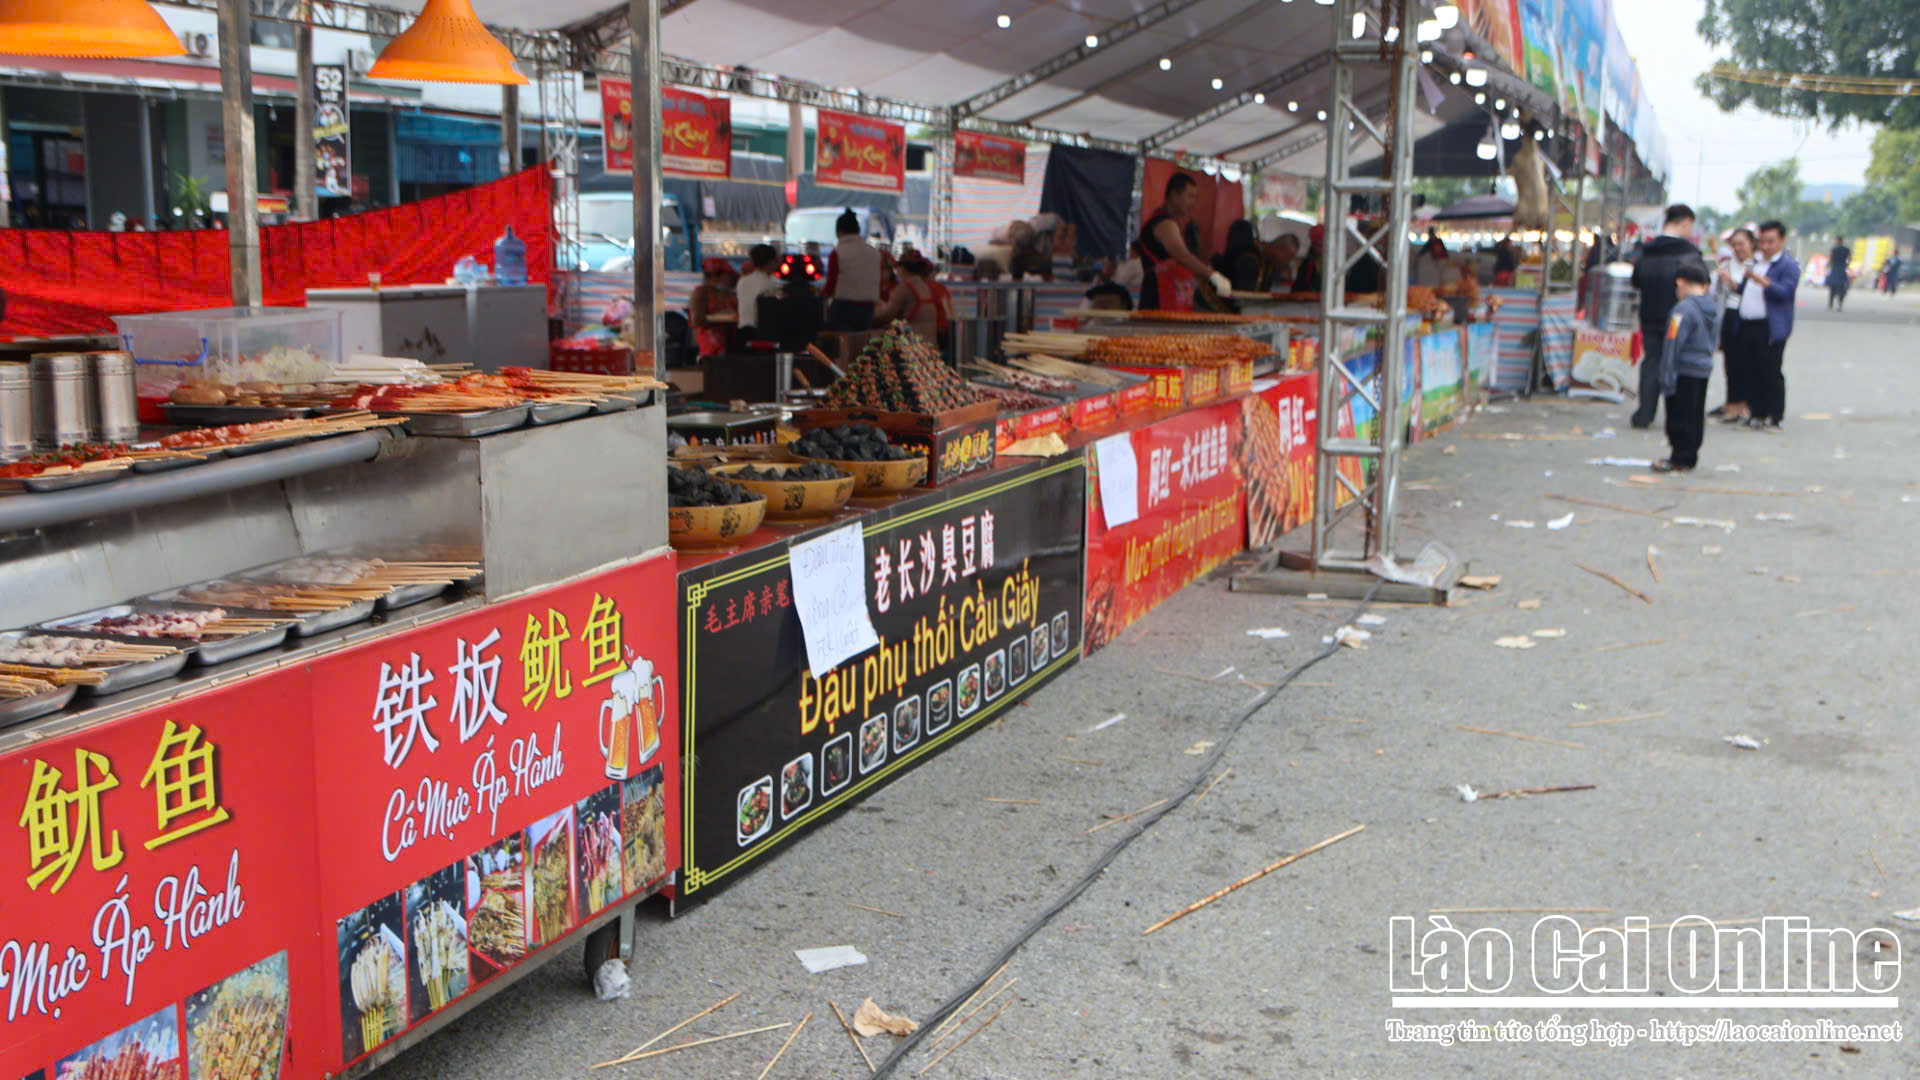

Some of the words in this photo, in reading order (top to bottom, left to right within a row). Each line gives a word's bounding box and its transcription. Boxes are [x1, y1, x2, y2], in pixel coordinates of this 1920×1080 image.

[316, 66, 343, 91] 52
[864, 634, 908, 719] phụ
[912, 594, 955, 681] thối
[959, 579, 998, 653] Cầu
[1001, 556, 1040, 630] Giấy
[874, 509, 996, 613] 老长沙臭豆腐
[372, 592, 628, 769] 铁板鱿鱼
[19, 719, 230, 894] 鱿鱼
[381, 788, 417, 862] Cá
[417, 776, 471, 841] Mực
[472, 733, 509, 837] Áp
[509, 721, 565, 797] Hành
[0, 939, 91, 1021] Mực
[93, 872, 154, 1006] Áp
[154, 848, 245, 950] Hành
